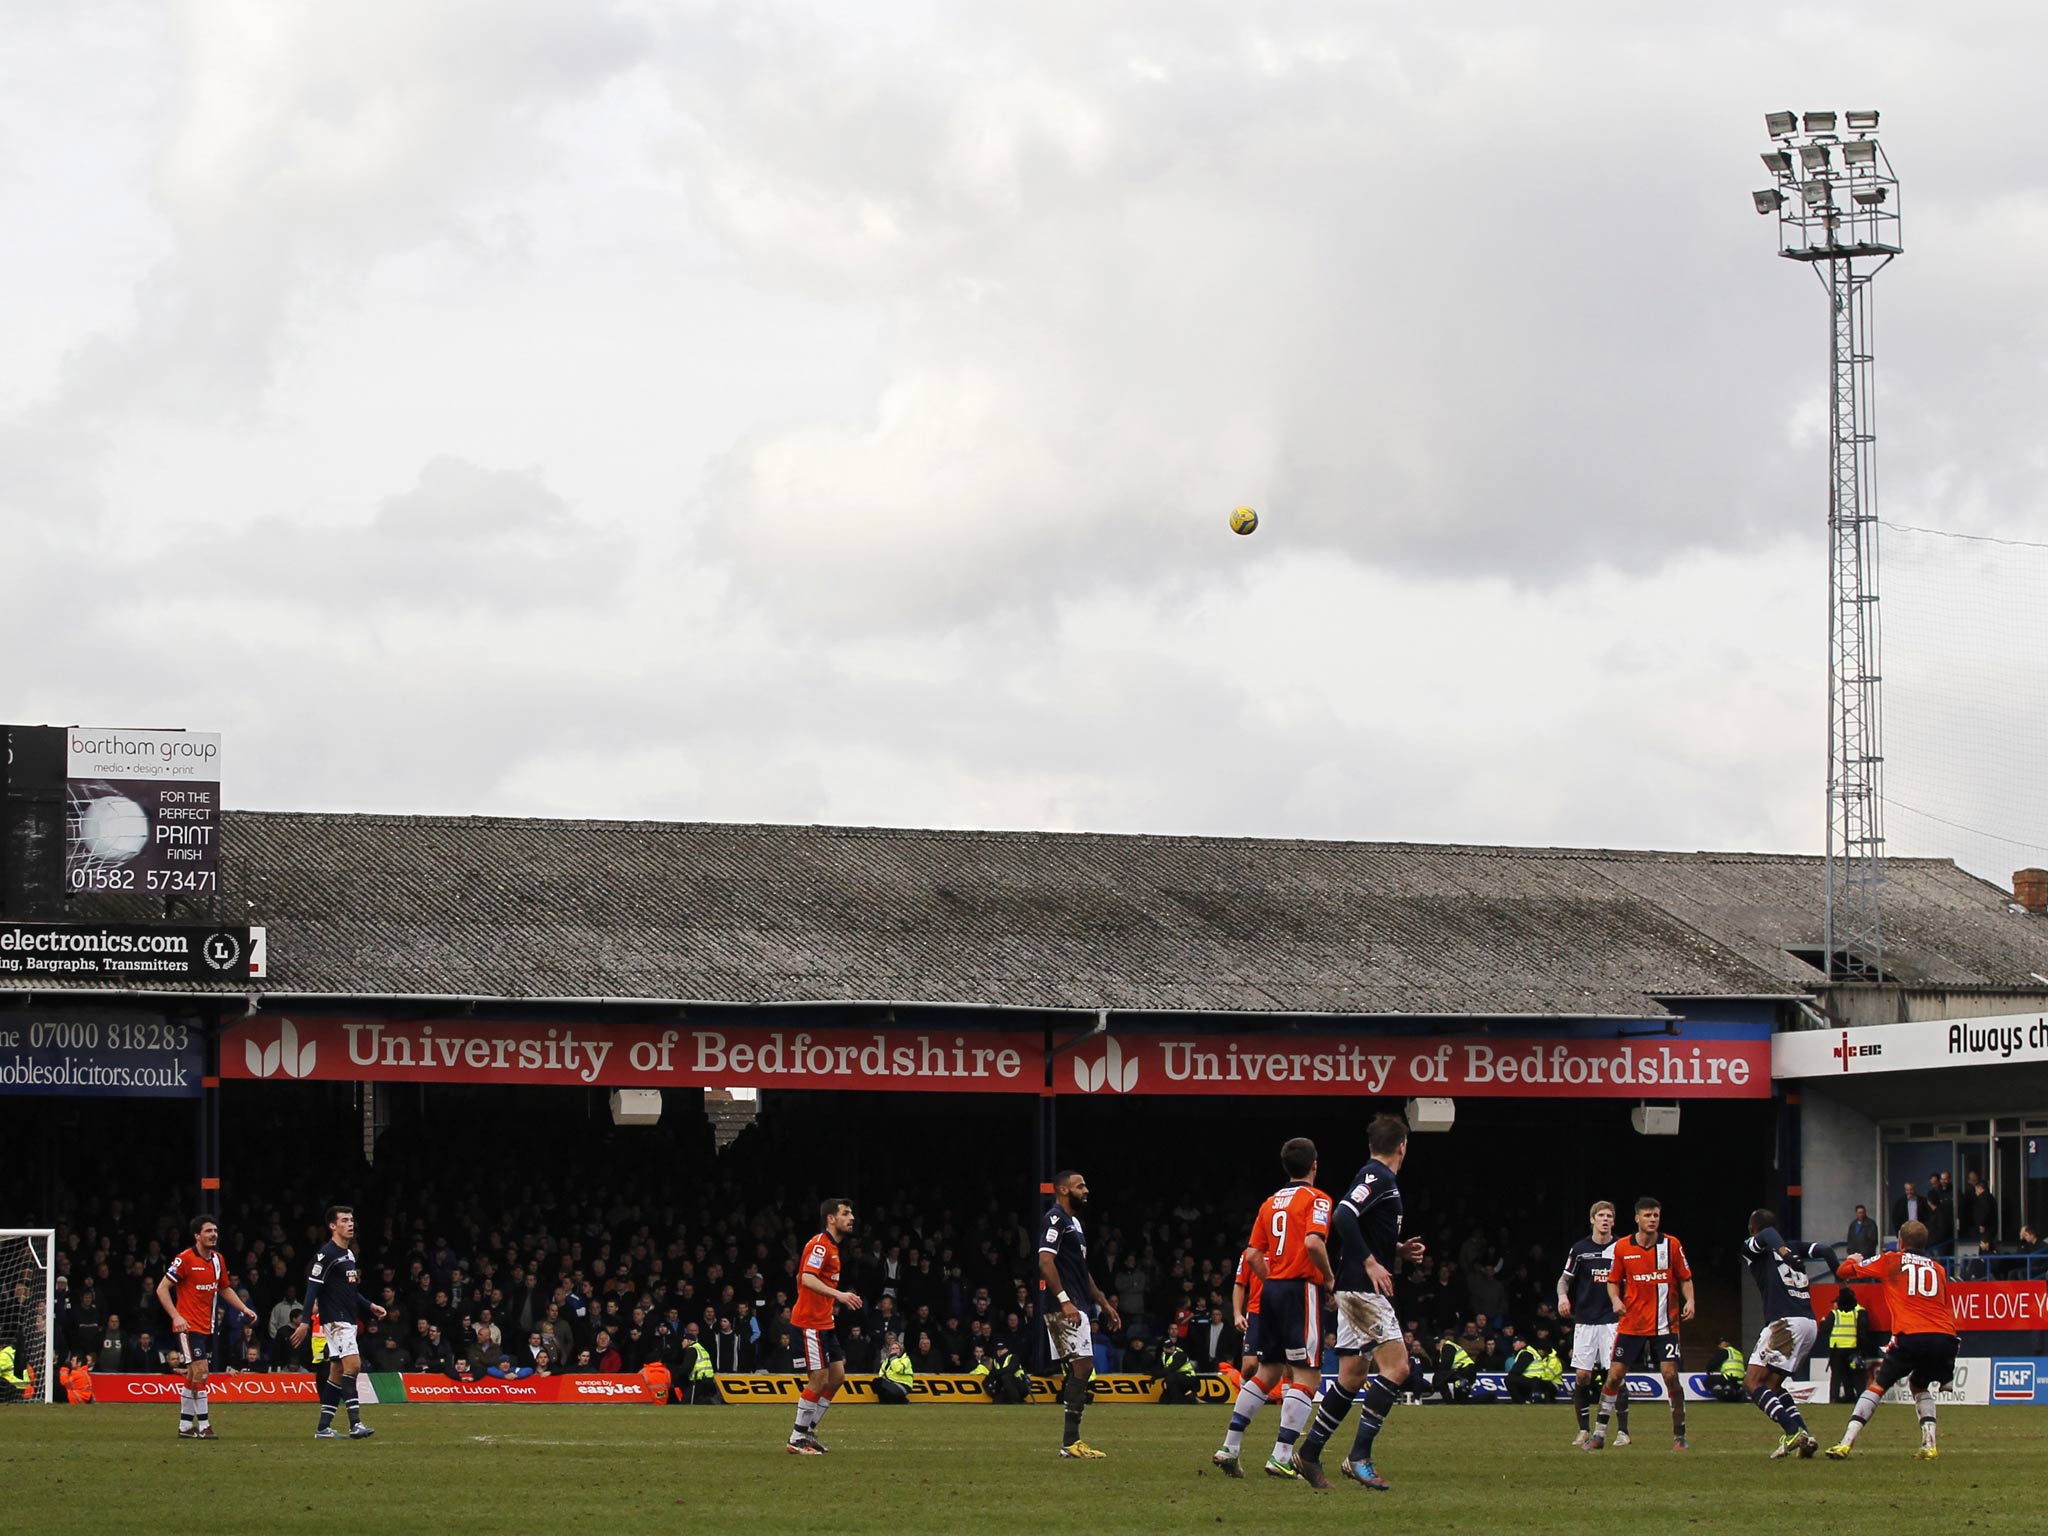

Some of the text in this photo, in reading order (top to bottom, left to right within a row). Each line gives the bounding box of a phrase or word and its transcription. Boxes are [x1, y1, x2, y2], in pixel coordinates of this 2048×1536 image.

[72, 735, 217, 763] bartham group
[94, 762, 195, 777] media design print
[160, 790, 211, 804] FOR THE
[159, 807, 212, 820] PERFECT
[156, 825, 214, 845] PRINT
[167, 848, 202, 861] FINISH
[71, 868, 216, 891] 01582 573471
[0, 929, 189, 954] electronics.com
[26, 957, 99, 973] Bargraphs,
[102, 958, 189, 972] Transmitters
[30, 1022, 99, 1049] 07000
[107, 1024, 189, 1050] 818283
[1948, 1023, 2023, 1058] Always
[342, 1025, 1021, 1083] University of Bedfordshire
[0, 1056, 188, 1087] oblesolicitors.co.uk
[1159, 1043, 1750, 1093] University of Bedfordshire
[1272, 1210, 1288, 1256] 9
[1901, 1263, 1939, 1298] 10
[1950, 1292, 2048, 1320] WE LOVE Y
[1665, 1343, 1681, 1359] 24
[230, 1380, 276, 1394] YOU
[1998, 1370, 2032, 1386] SKF
[408, 1384, 537, 1396] support Luton Town
[577, 1383, 643, 1396] easyJet
